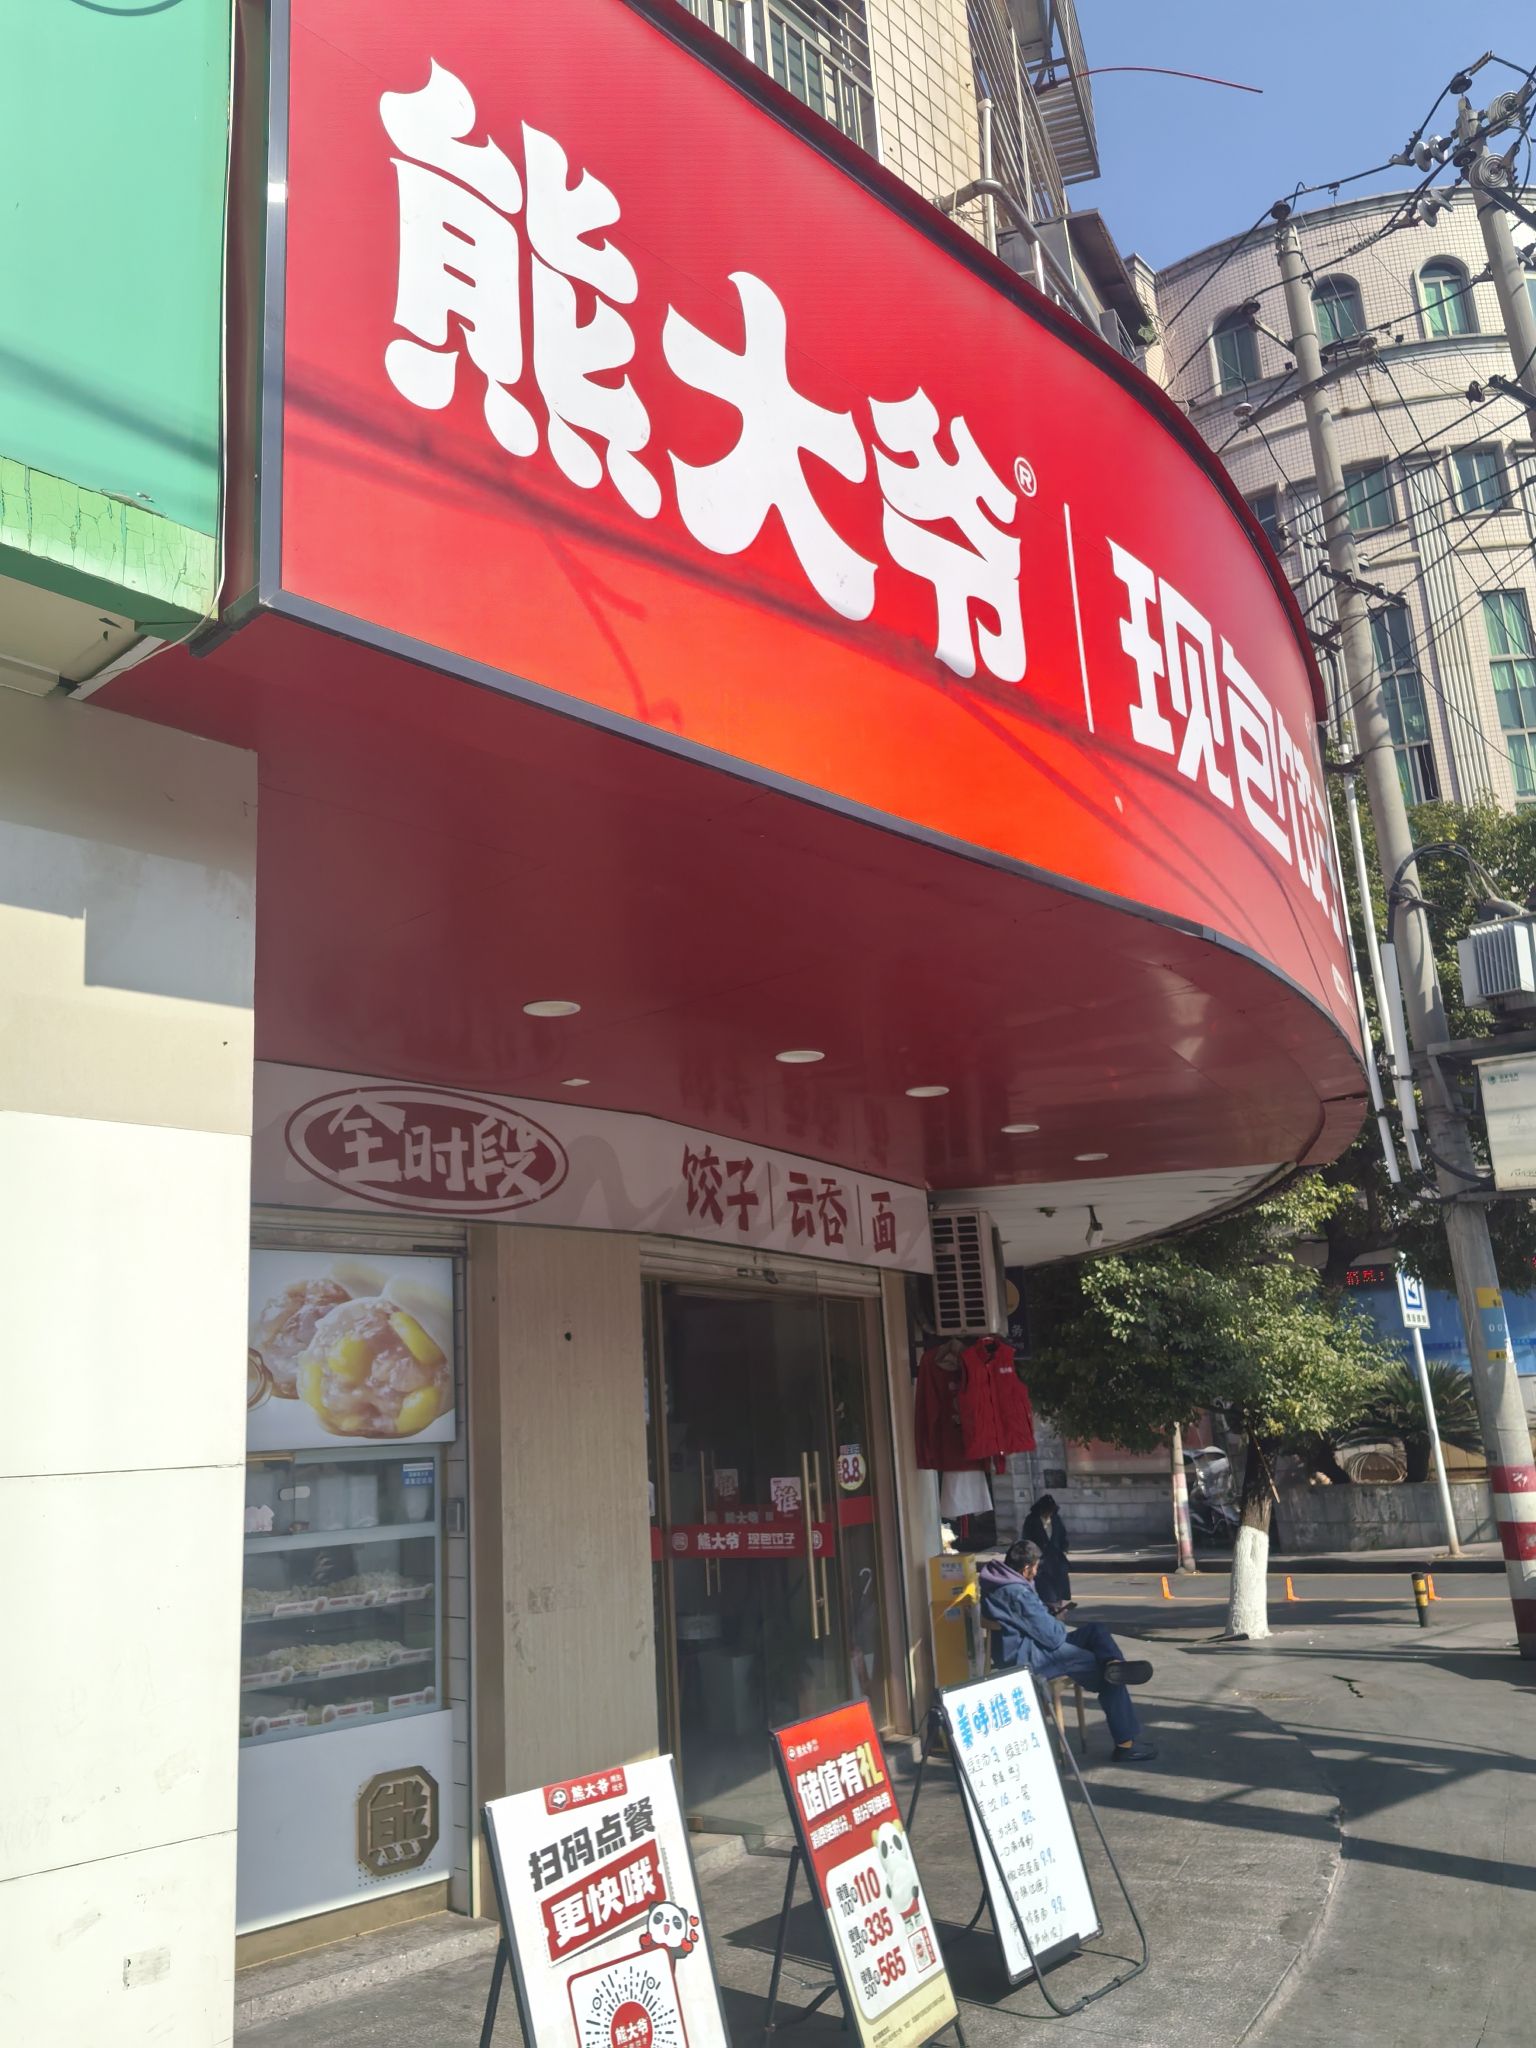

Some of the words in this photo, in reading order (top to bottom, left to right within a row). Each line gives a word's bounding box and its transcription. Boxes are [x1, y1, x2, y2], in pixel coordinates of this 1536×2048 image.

[380, 57, 1026, 683] 熊大爷
[328, 1090, 542, 1200] 全时段
[683, 1144, 760, 1230] 饺子
[787, 1172, 848, 1244] 云吞
[871, 1191, 898, 1253] 面
[775, 1486, 799, 1513] 推
[697, 1532, 740, 1550] 熊大爷
[571, 1778, 609, 1802] 熊大爷
[797, 1741, 884, 1821] 储值有礼
[528, 1796, 655, 1892] 扫码点餐
[551, 1856, 656, 1948] 更快哦
[854, 1867, 881, 1906] 110
[841, 1900, 854, 1917] 100
[865, 1907, 893, 1946] 335
[877, 1946, 906, 1987] 565
[864, 1982, 877, 2000] 500
